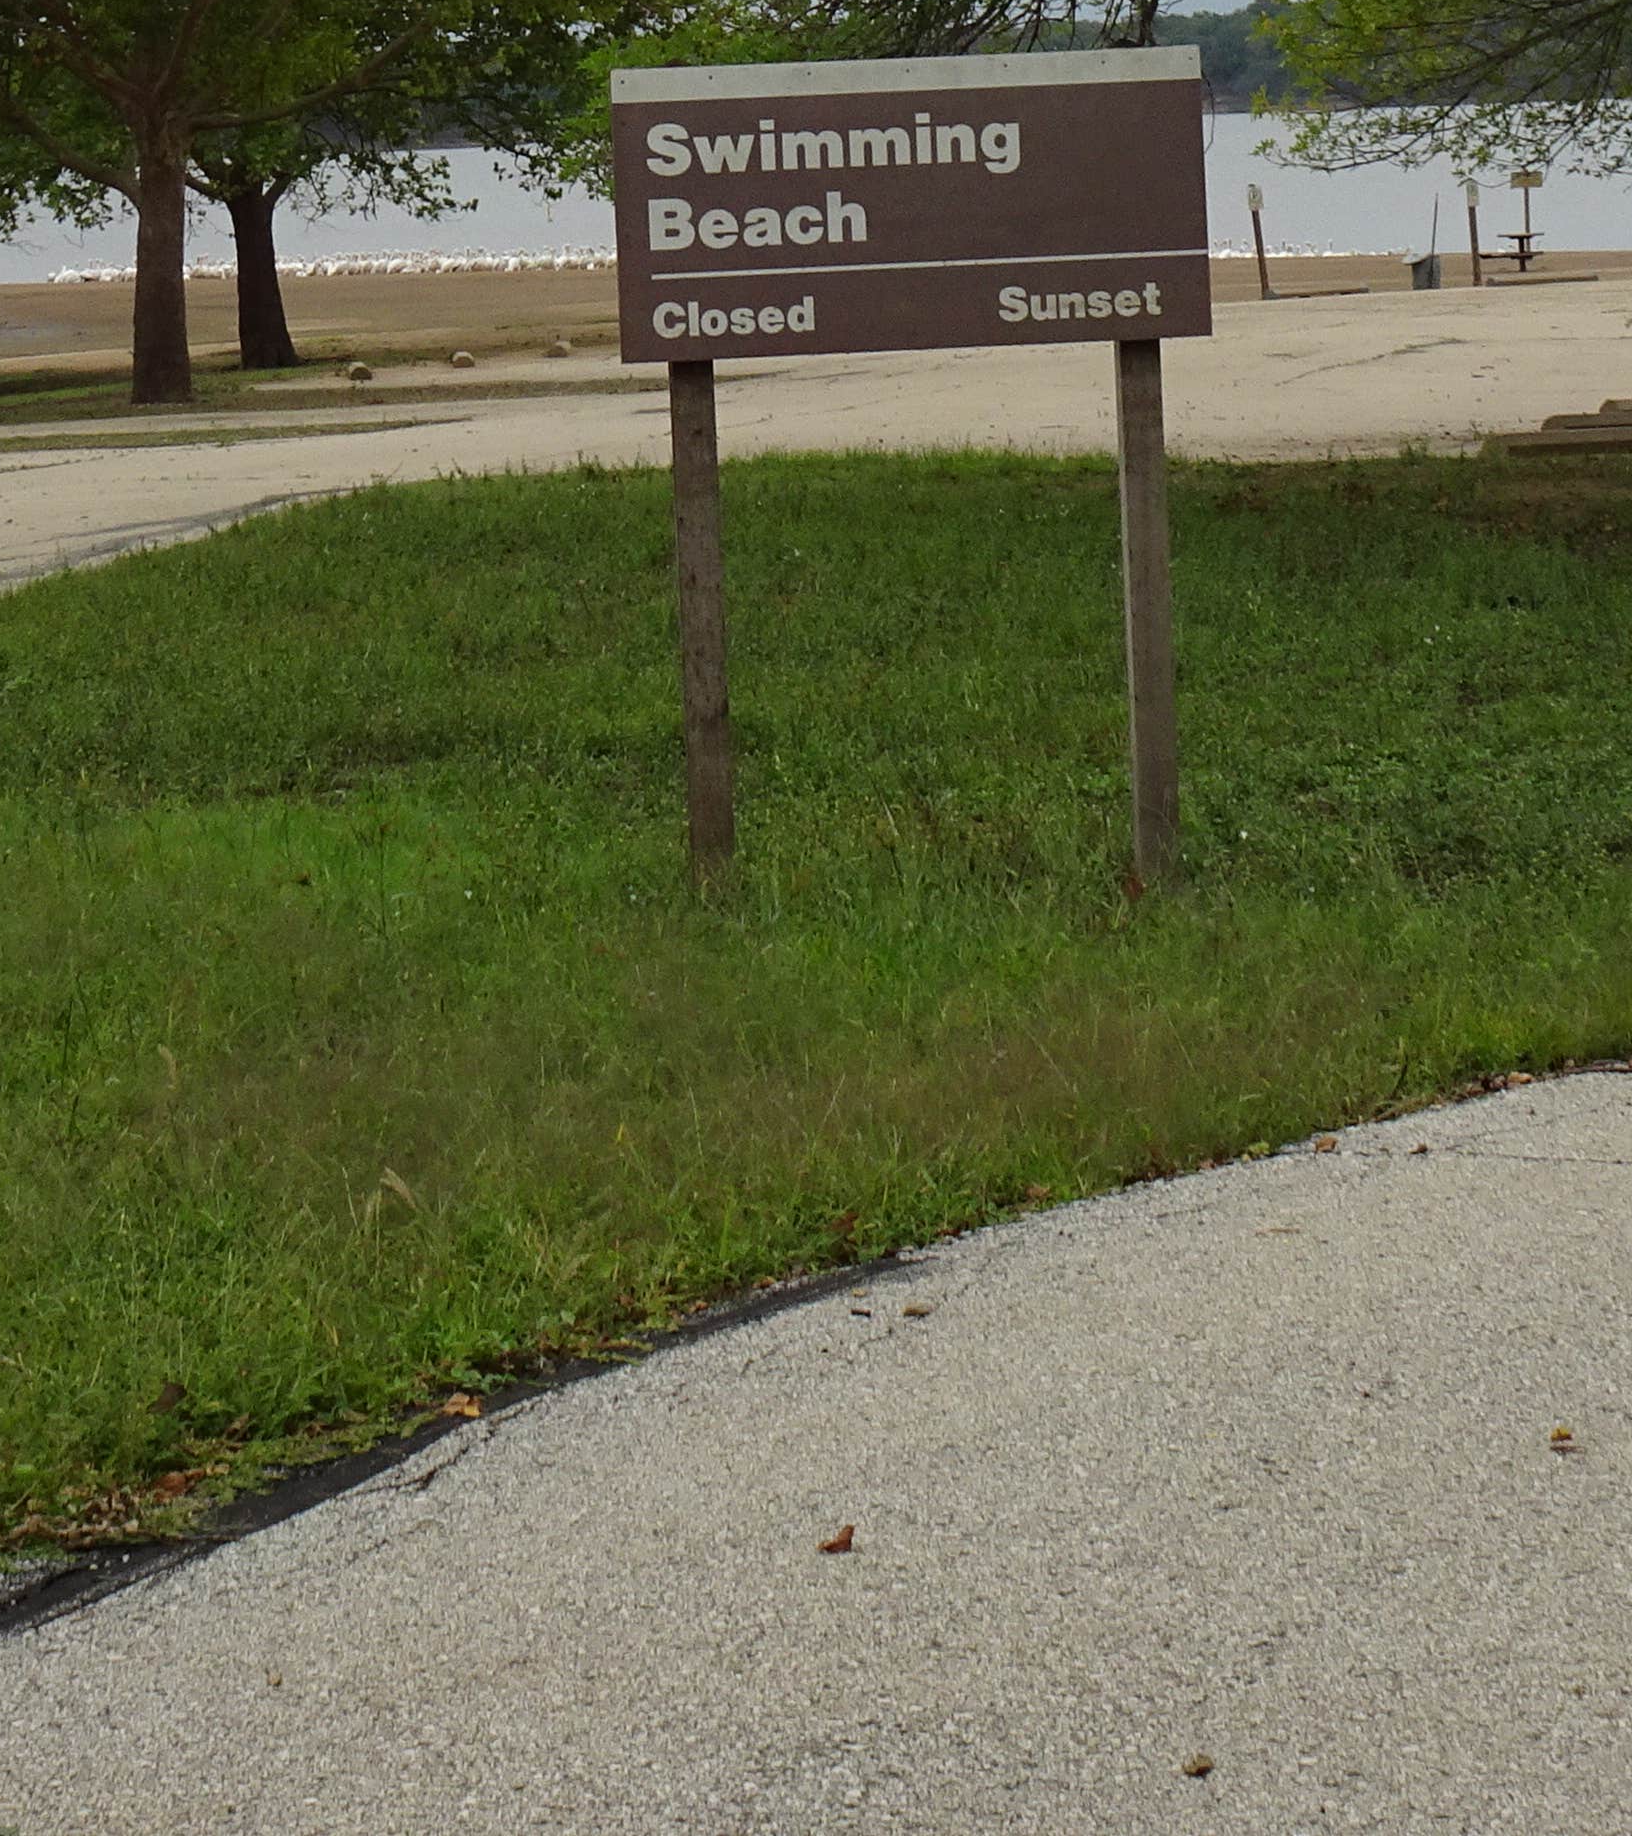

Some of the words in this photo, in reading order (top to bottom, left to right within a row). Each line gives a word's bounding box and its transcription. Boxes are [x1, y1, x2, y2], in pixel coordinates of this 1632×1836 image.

[646, 112, 1021, 177] Swimming
[647, 191, 868, 251] Beach
[652, 295, 816, 339] Closed
[998, 282, 1162, 323] Sunset
